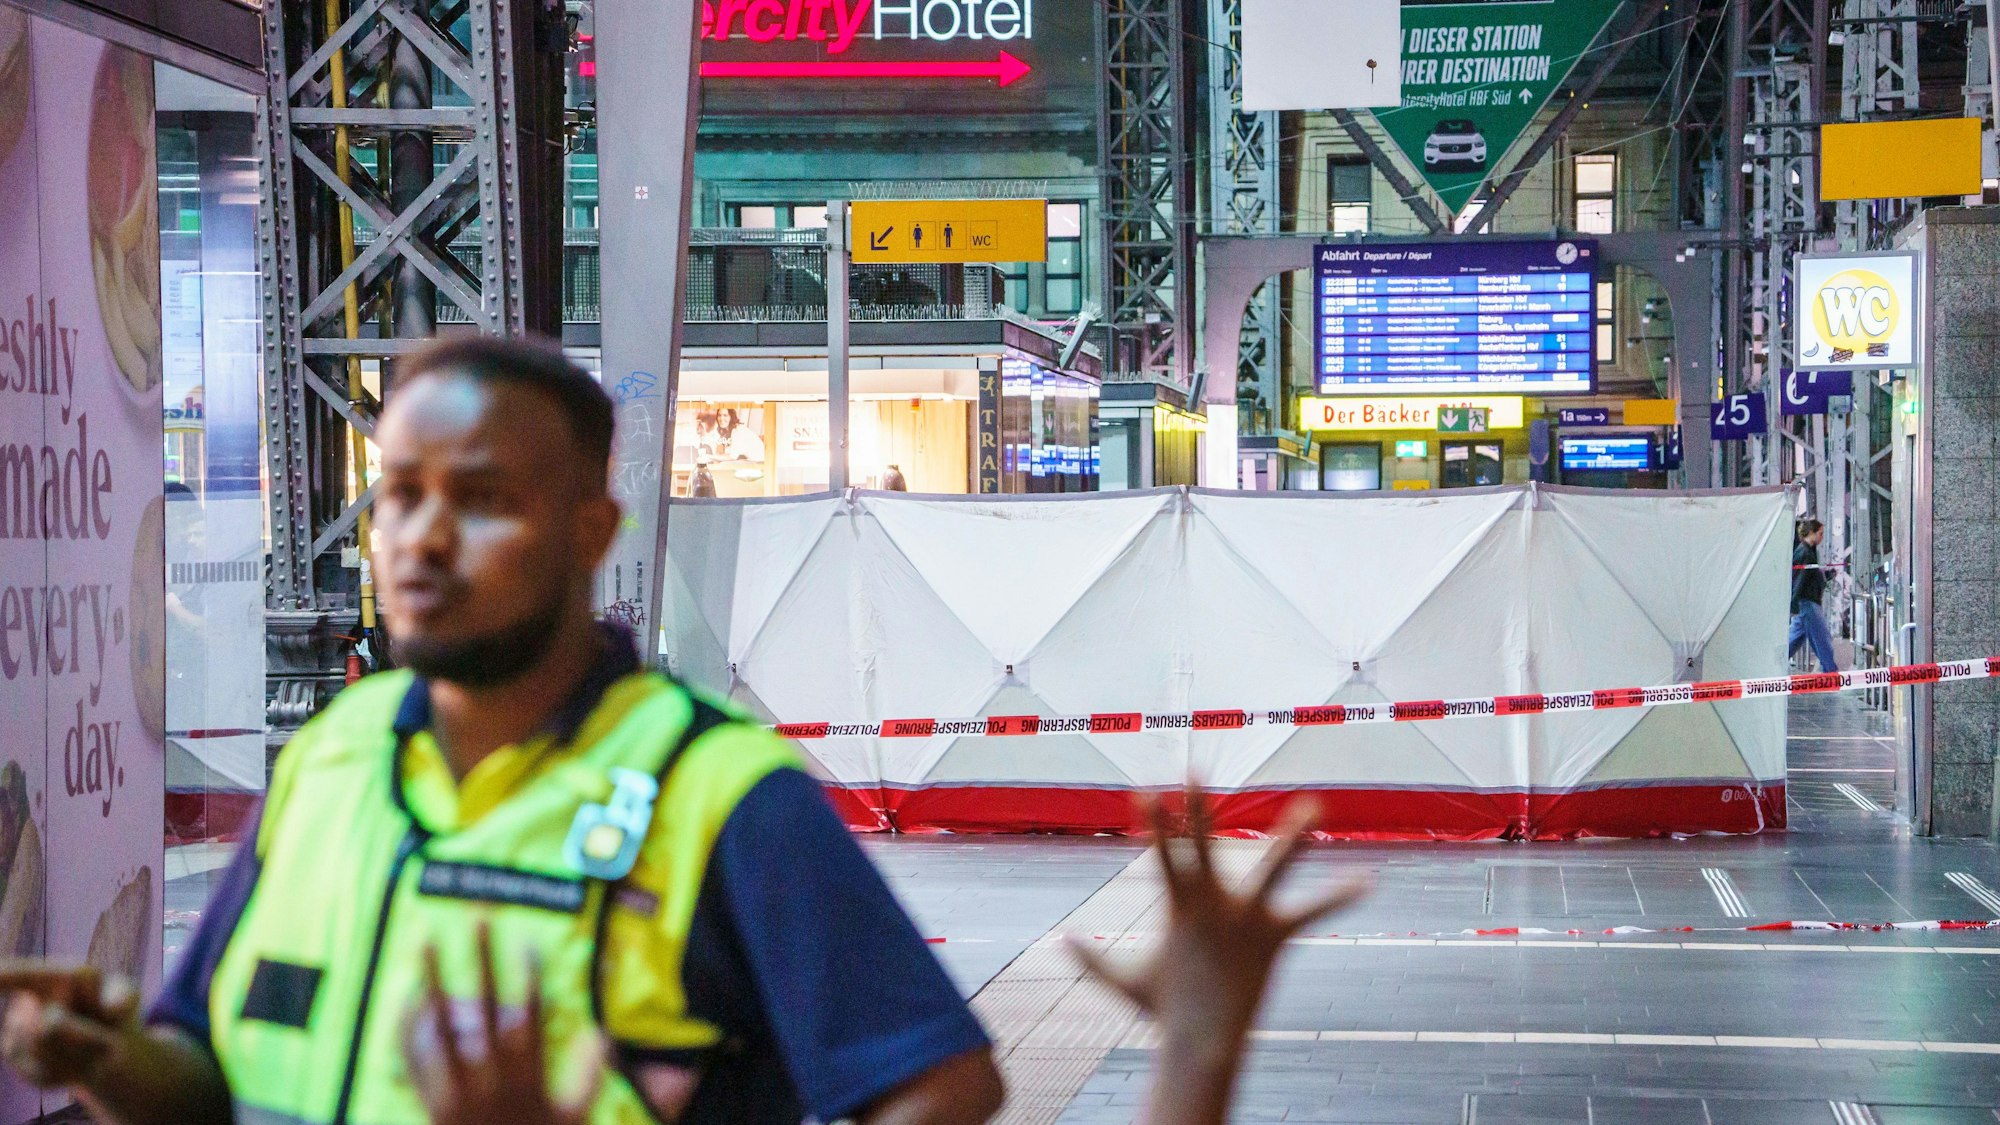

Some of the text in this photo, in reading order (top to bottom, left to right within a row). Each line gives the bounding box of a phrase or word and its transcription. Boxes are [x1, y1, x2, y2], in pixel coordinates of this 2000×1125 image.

[1409, 27, 1469, 53] DIESER
[1472, 24, 1543, 51] STATION
[1441, 55, 1550, 84] DESTINATION
[1469, 90, 1489, 106] HBF
[1492, 89, 1512, 105] Süd
[972, 235, 991, 247] WC
[1322, 250, 1361, 261] Abfahrt
[1363, 252, 1402, 261] Departure
[1408, 251, 1432, 261] Départ
[1820, 286, 1890, 337] WC
[1324, 405, 1355, 423] Der
[1363, 403, 1430, 423] Bäcker
[1561, 410, 1574, 421] 1a
[1730, 395, 1750, 426] 5
[1655, 445, 1664, 464] 1
[0, 412, 112, 540] made
[895, 718, 1006, 734] POLIZEIABSPERRUNG
[1022, 716, 1131, 732] POLIZEIABSPERRUNG
[1147, 712, 1254, 728] POLIZEIABSPERRUNG
[1269, 707, 1375, 725] POLIZEIABSPERRUNG
[1389, 701, 1495, 719] POLIZEIABSPERRUNG
[1509, 691, 1614, 712] POLIZEIABSPERRUNG
[1865, 664, 1971, 685] POLIZEIABSPERRUNG
[64, 698, 124, 818] day.
